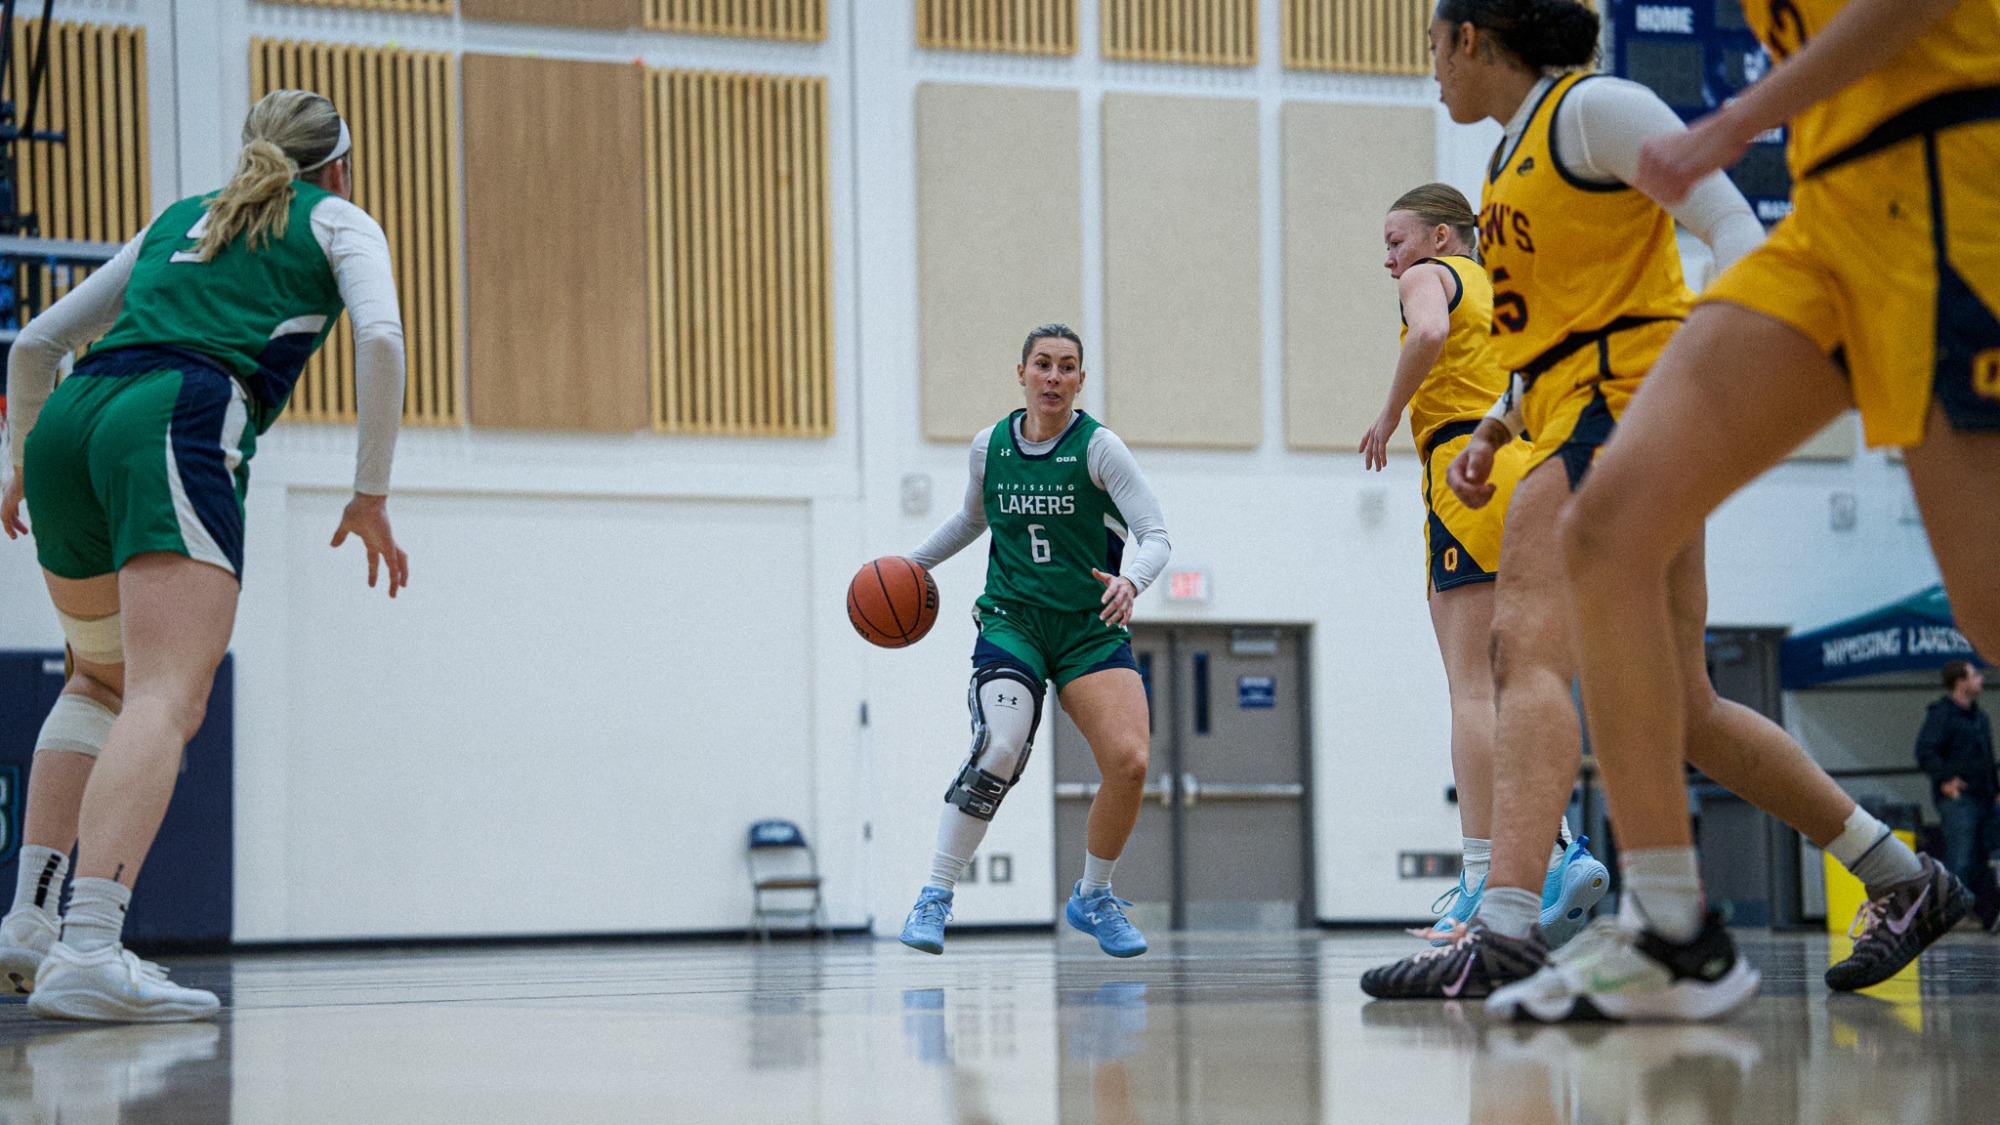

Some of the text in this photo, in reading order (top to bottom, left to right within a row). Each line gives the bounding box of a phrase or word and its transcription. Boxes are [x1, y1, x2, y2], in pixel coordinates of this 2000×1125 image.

[998, 483, 1075, 491] NIPISSING
[998, 494, 1075, 515] LAKERS
[1027, 524, 1051, 563] 6
